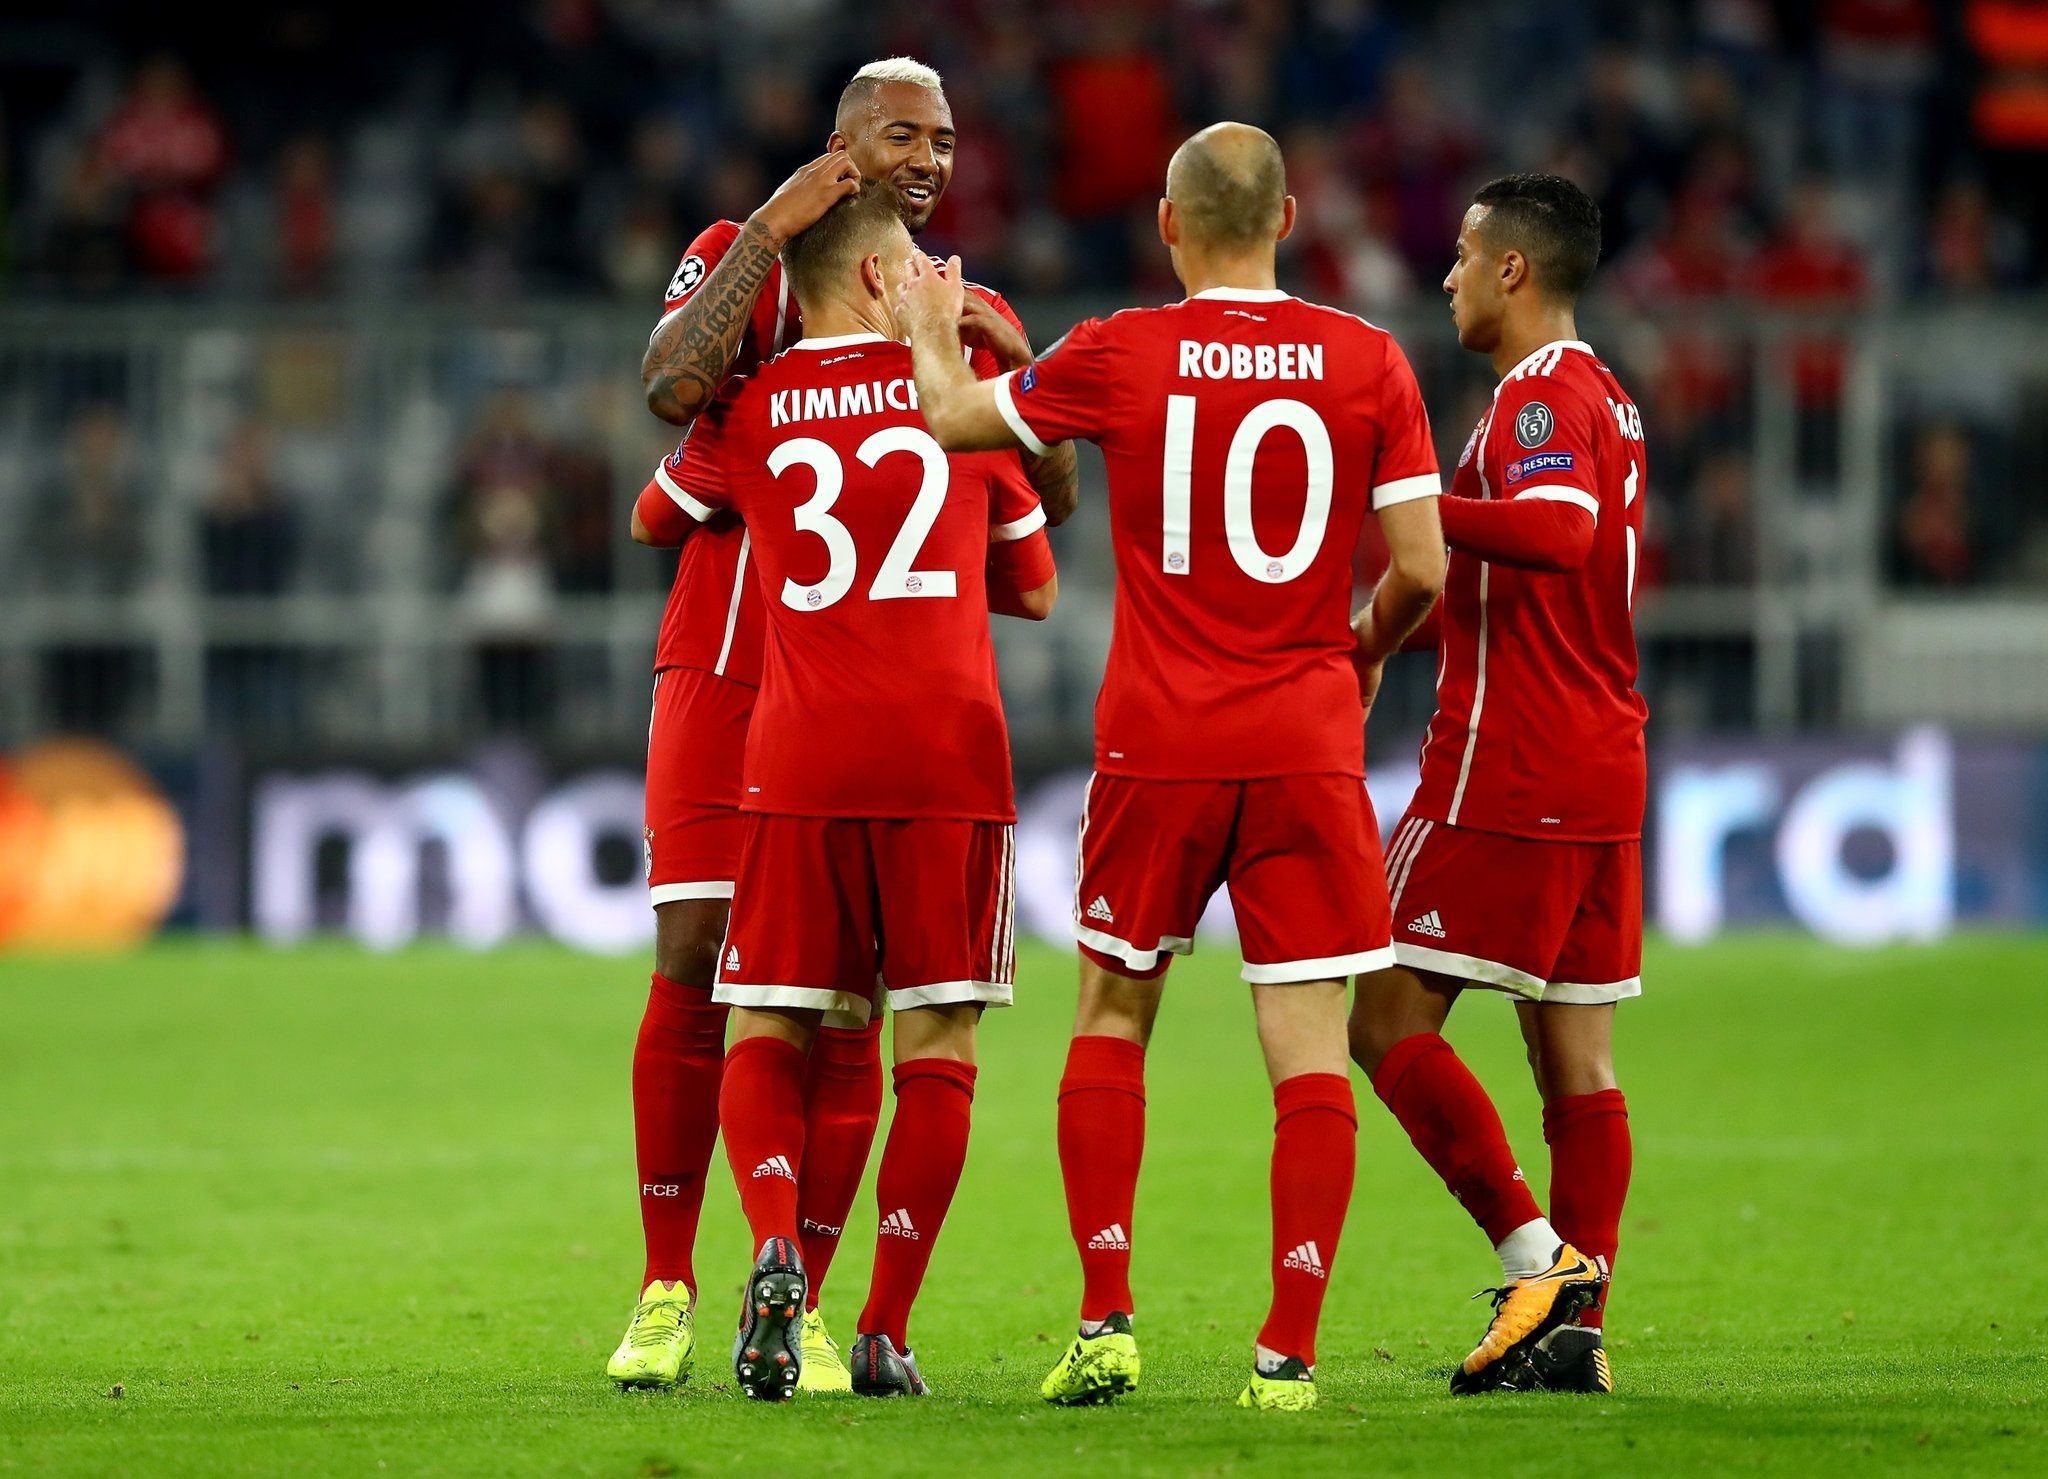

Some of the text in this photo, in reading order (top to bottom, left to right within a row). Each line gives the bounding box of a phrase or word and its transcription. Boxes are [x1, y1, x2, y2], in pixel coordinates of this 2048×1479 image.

[1179, 340, 1324, 381] ROBBEN
[1530, 423, 1539, 437] 5
[1523, 456, 1572, 472] RESPECT
[1163, 394, 1334, 584] 10
[766, 426, 958, 612] 32
[1407, 922, 1446, 939] adidas
[643, 1183, 679, 1197] FCB
[879, 1224, 920, 1240] adidas
[1088, 1240, 1130, 1250] adidas
[1283, 1257, 1325, 1279] adidas
